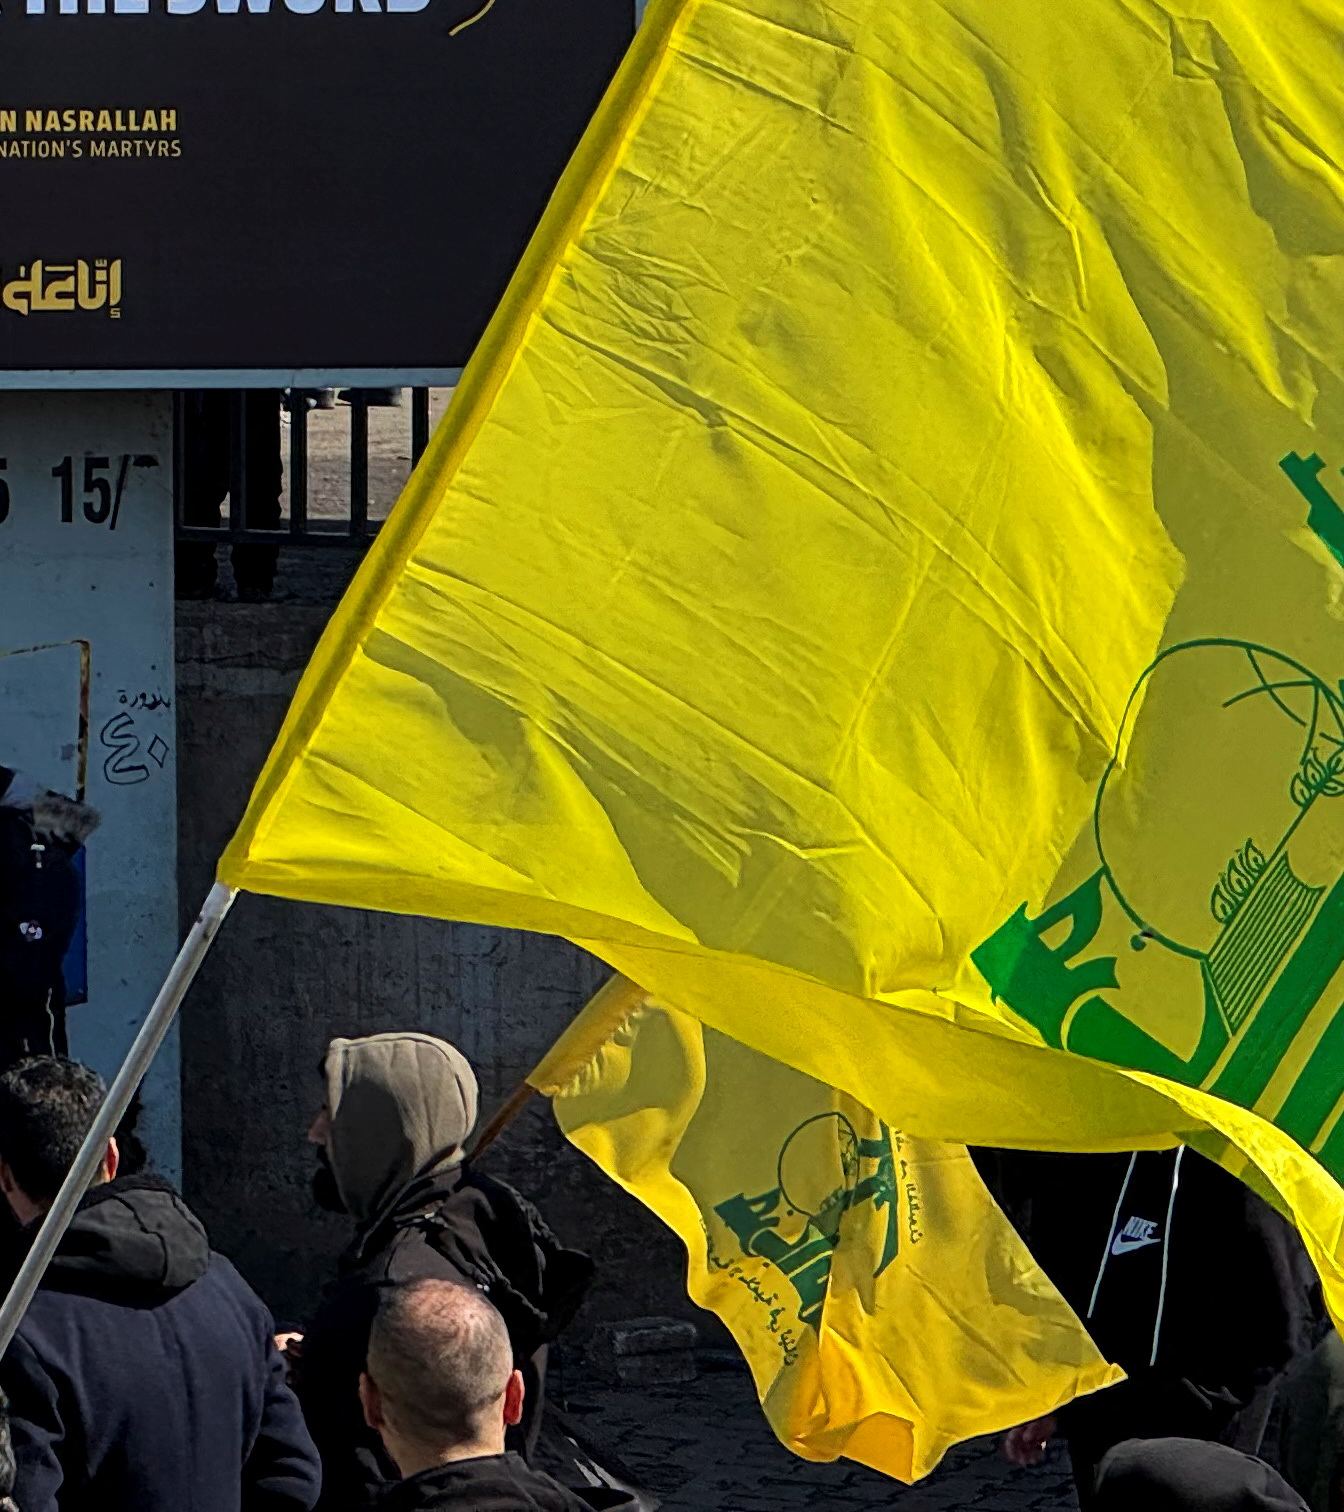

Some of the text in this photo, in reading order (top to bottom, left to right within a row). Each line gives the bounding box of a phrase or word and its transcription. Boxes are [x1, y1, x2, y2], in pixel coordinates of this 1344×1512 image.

[26, 110, 177, 132] NASRALLAH
[91, 140, 182, 158] MARTYRS
[1122, 1215, 1158, 1239] NIKE
